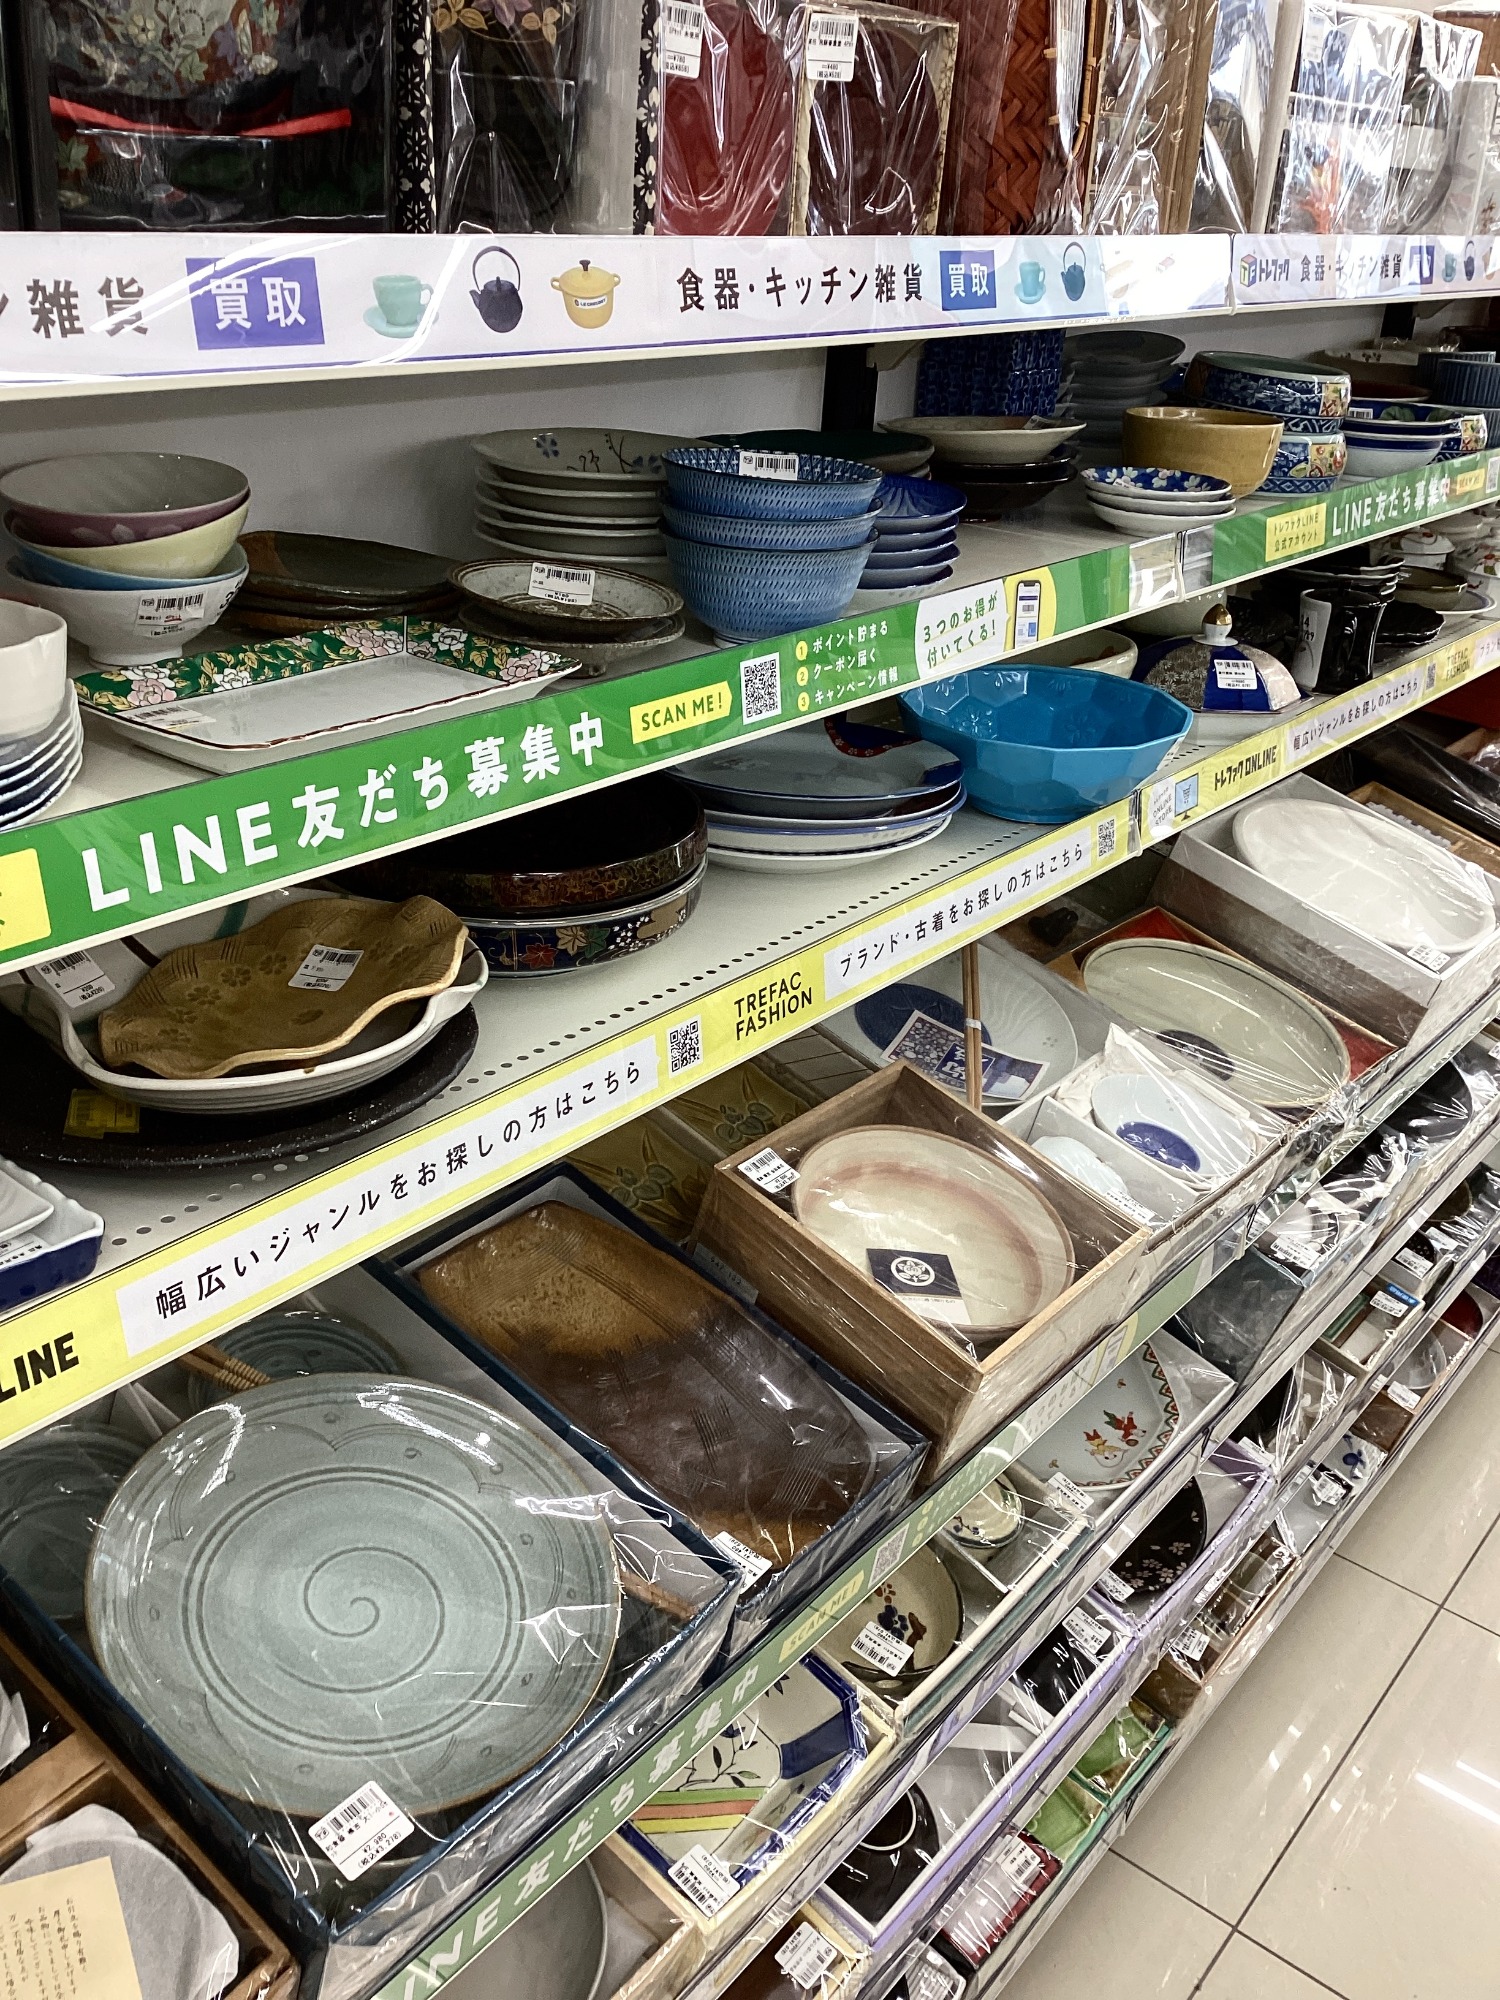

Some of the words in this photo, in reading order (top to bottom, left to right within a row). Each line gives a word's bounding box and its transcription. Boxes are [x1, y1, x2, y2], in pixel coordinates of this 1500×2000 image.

[211, 277, 307, 331] 買取
[676, 262, 924, 313] 食器・キッチン雑貨
[948, 261, 990, 299] 買取
[1332, 497, 1372, 537] LINE
[1374, 474, 1450, 523] 友だち募集中
[1273, 530, 1319, 553] 公式アカウント
[812, 620, 888, 654] ポイント貯まる
[923, 590, 998, 644] 3つのお得が
[813, 647, 876, 680] クーポン届く
[926, 619, 997, 669] 付いてくる!
[814, 665, 899, 705] キャンペーン情報
[640, 704, 689, 732] SCAN
[1293, 678, 1419, 751] 幅広いジャンルをお探しの方はこちら
[1213, 758, 1243, 792] トレファク
[1244, 745, 1277, 778] ONLINE
[81, 801, 279, 912] LINE
[291, 711, 605, 849] 友だち募集中
[840, 842, 1083, 978] ブランド・古着をお探しの方はこちら
[734, 971, 803, 1019] TREFAC
[736, 987, 814, 1041] FASHION
[154, 1060, 641, 1322] 幅広いジャンルをお探しの方はこちら
[789, 1607, 827, 1650] SCAN
[513, 1664, 760, 1907] 友だち募集中
[362, 1832, 387, 1854] ¥2,980
